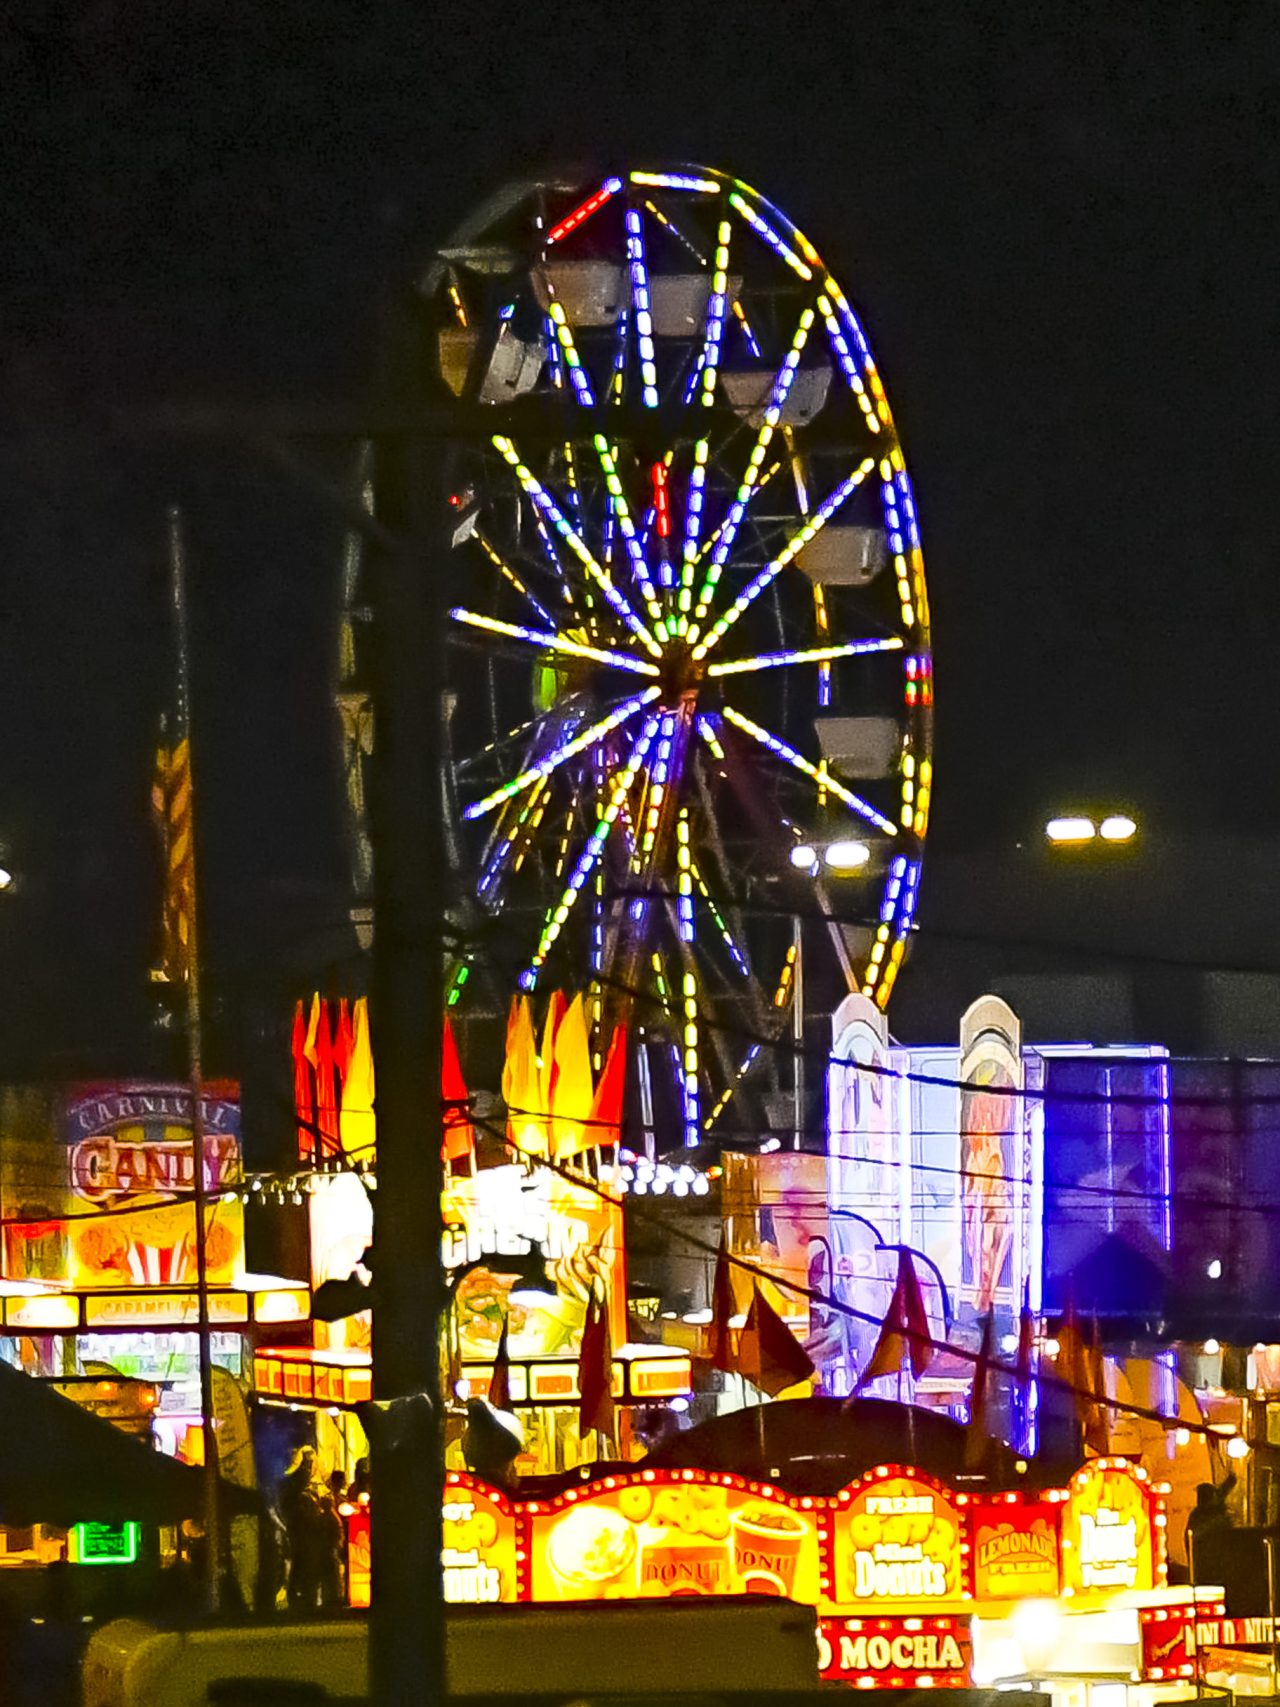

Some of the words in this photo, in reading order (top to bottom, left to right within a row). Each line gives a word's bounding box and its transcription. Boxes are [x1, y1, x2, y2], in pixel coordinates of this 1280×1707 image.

[442, 1503, 475, 1521] OT
[866, 1497, 933, 1514] FRESH
[854, 1551, 947, 1597] Donuts
[839, 1634, 964, 1670] MOCHA
